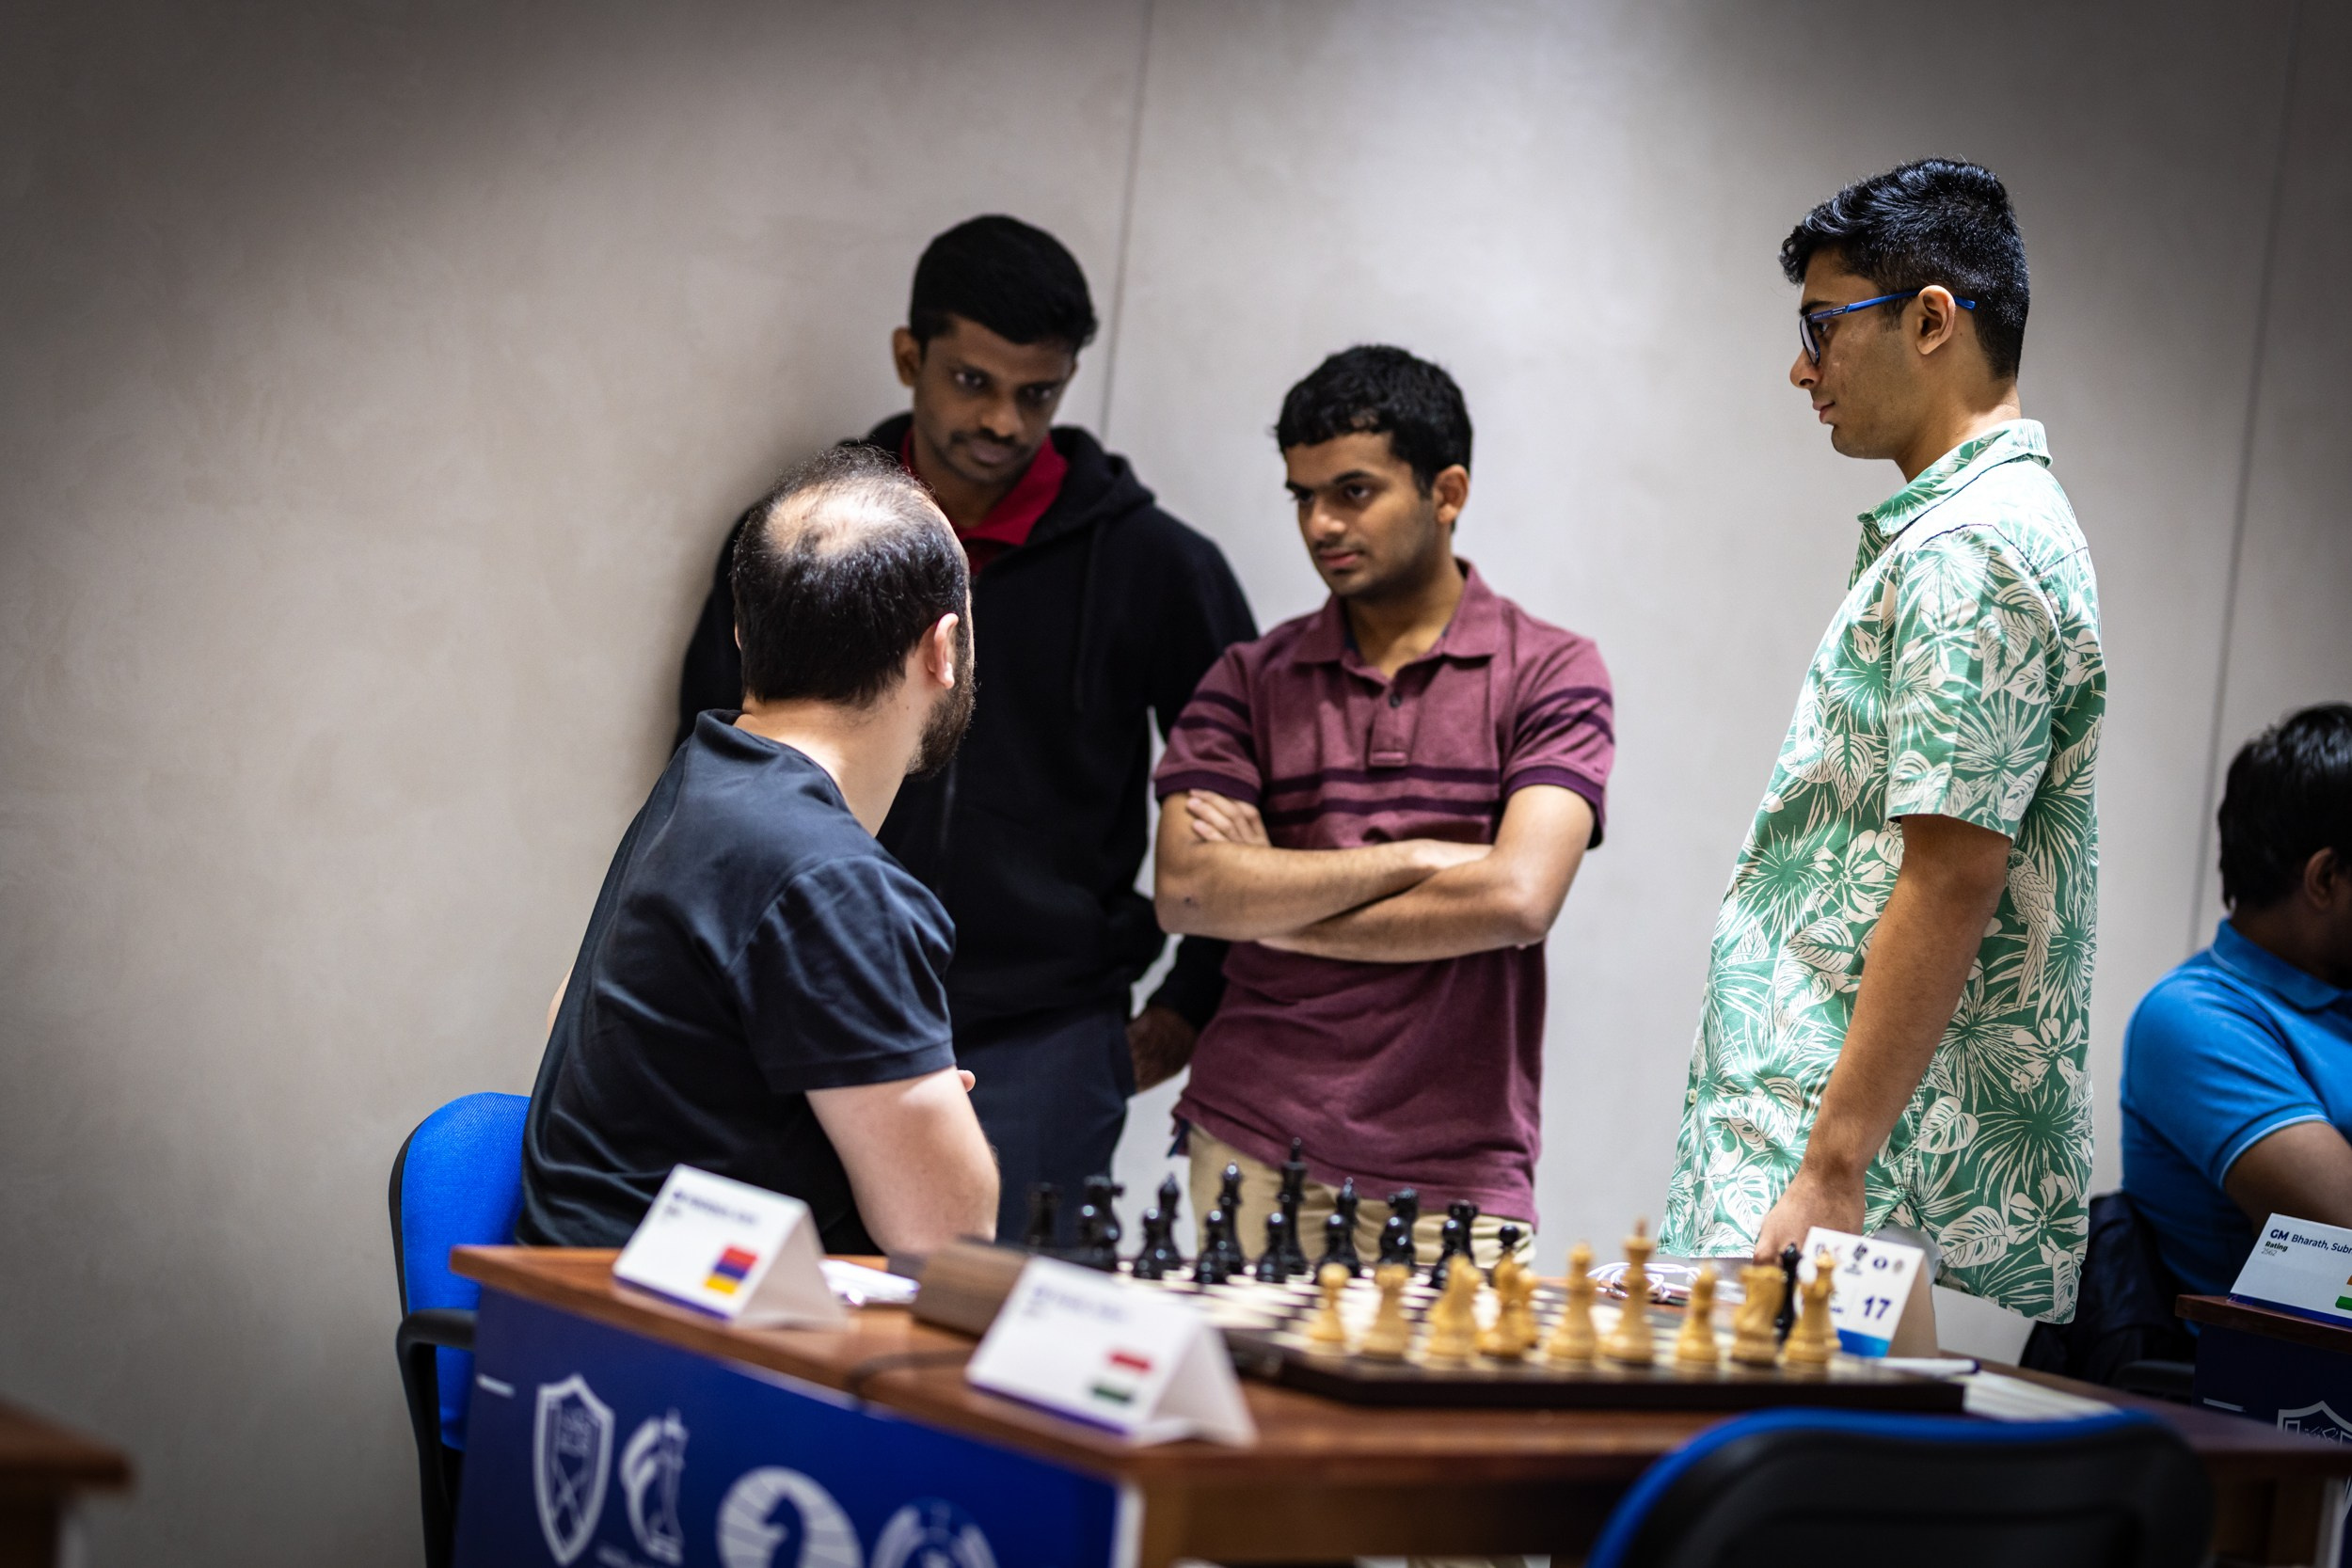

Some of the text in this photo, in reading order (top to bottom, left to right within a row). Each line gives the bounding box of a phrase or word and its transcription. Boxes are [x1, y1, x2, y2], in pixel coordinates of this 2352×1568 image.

[2265, 1241, 2288, 1252] Rating
[2270, 1228, 2290, 1241] GM
[2291, 1234, 2328, 1251] Bharath,
[1864, 1294, 1891, 1321] 17
